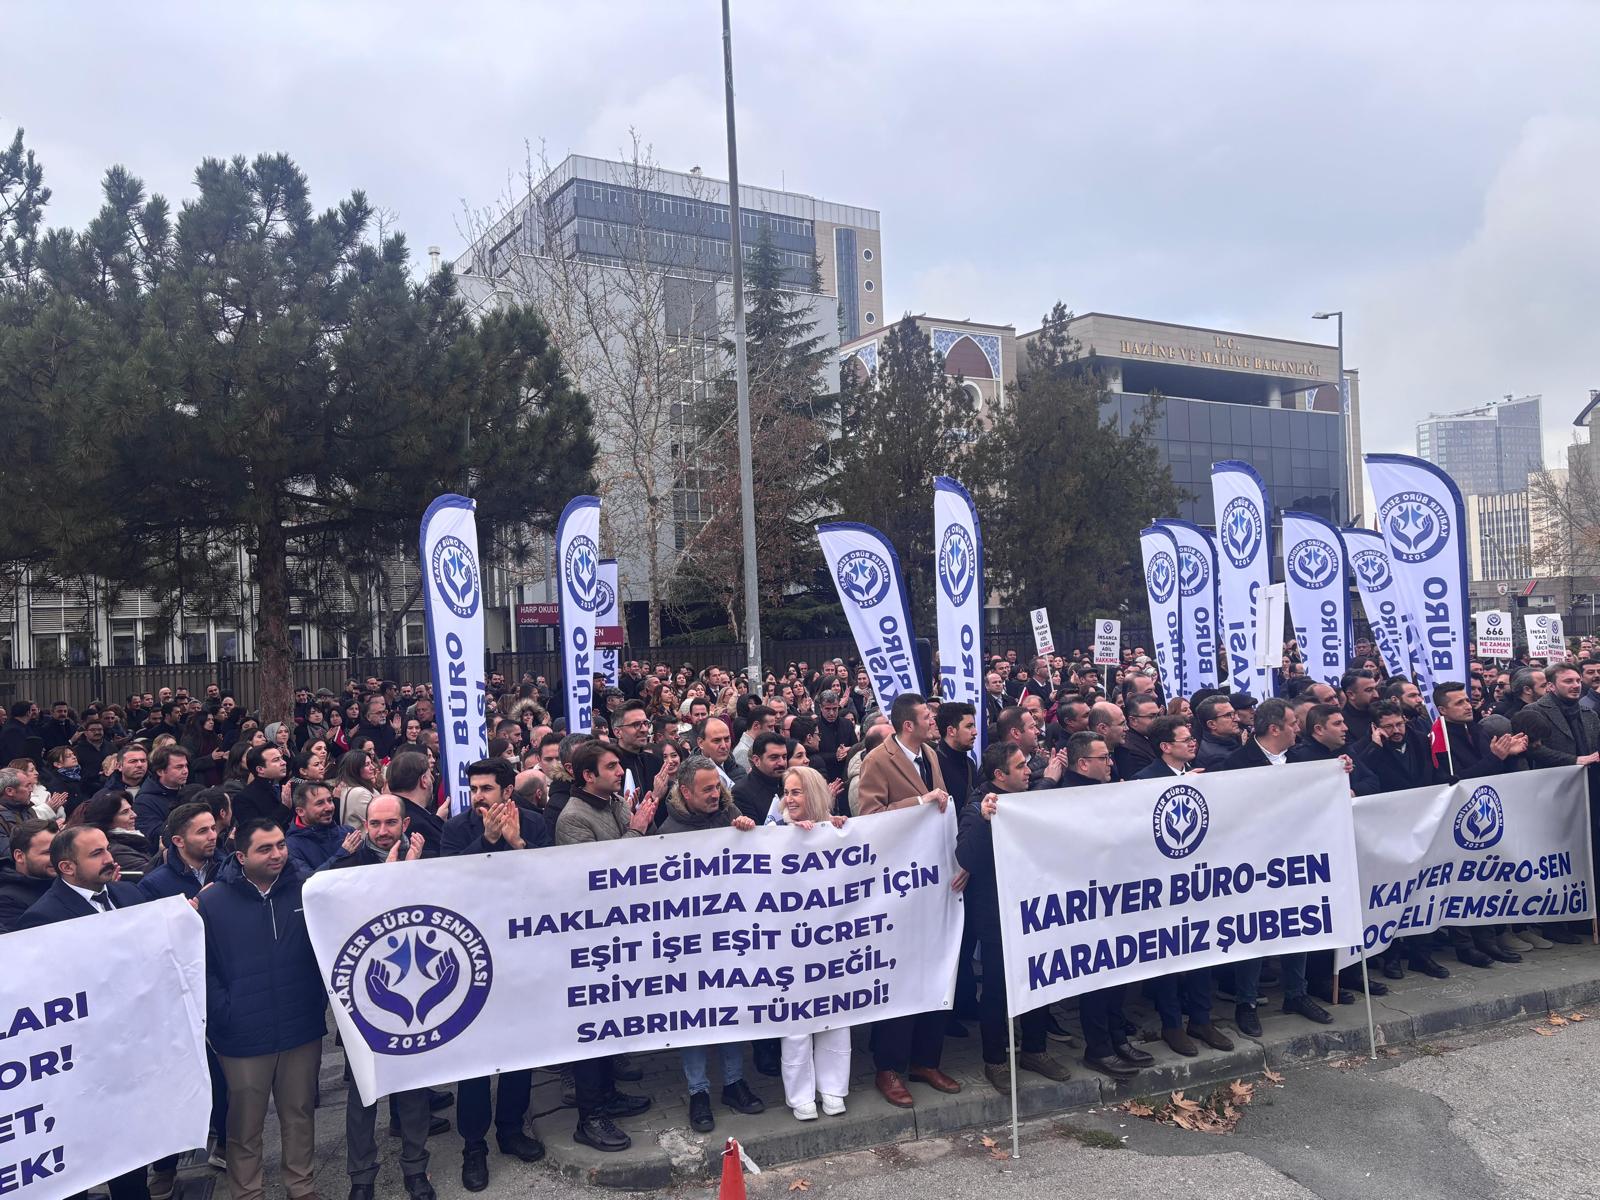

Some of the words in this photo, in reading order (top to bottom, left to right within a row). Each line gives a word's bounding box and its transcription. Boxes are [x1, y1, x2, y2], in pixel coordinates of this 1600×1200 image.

[1120, 340, 1176, 360] HAZİNE
[1179, 347, 1197, 361] VE
[1200, 350, 1249, 368] MALİYE
[1254, 357, 1320, 376] BAKANLIĞI
[521, 606, 538, 614] HARP
[538, 606, 559, 614] OKULU
[1486, 627, 1503, 636] 666
[446, 632, 469, 745] BÜRO
[573, 626, 592, 729] BÜRO
[1154, 798, 1166, 838] KARİYER
[1165, 787, 1186, 799] BÜRO
[1187, 788, 1208, 828] SENDİKASI
[588, 847, 772, 891] EMEĞİMİZE
[781, 843, 877, 875] SAYGI,
[1170, 848, 1189, 856] 2024
[1463, 841, 1485, 849] 2024
[508, 891, 747, 940] HAKLARIMIZA
[755, 878, 876, 913] ADALET
[882, 861, 940, 898] İÇİN
[1020, 878, 1163, 936] KARİYER
[1169, 853, 1331, 906] BÜRO-SEN
[1369, 862, 1453, 909] KARYER
[1457, 851, 1571, 883] BÜRO-SEN
[370, 909, 425, 938] BÜRO
[431, 911, 488, 987] SENDİKASI
[570, 935, 642, 973] EŞİT
[652, 931, 702, 964] İŞE
[713, 923, 781, 957] EŞİT
[791, 912, 894, 948] ÜCRET.
[1027, 916, 1211, 991] KARADENİZ
[1215, 896, 1333, 953] ŞUBESİ
[1350, 895, 1435, 956] OCELİ
[1439, 880, 1588, 921] TEMSİLCİLİĞİ
[567, 972, 687, 1008] ERİYEN
[698, 966, 794, 992] MAAŞ
[804, 945, 897, 984] DEĞİL,
[388, 1030, 441, 1049] 2024
[577, 1005, 739, 1044] SABRIMIZ
[748, 983, 890, 1026] TÜKENDİ!
